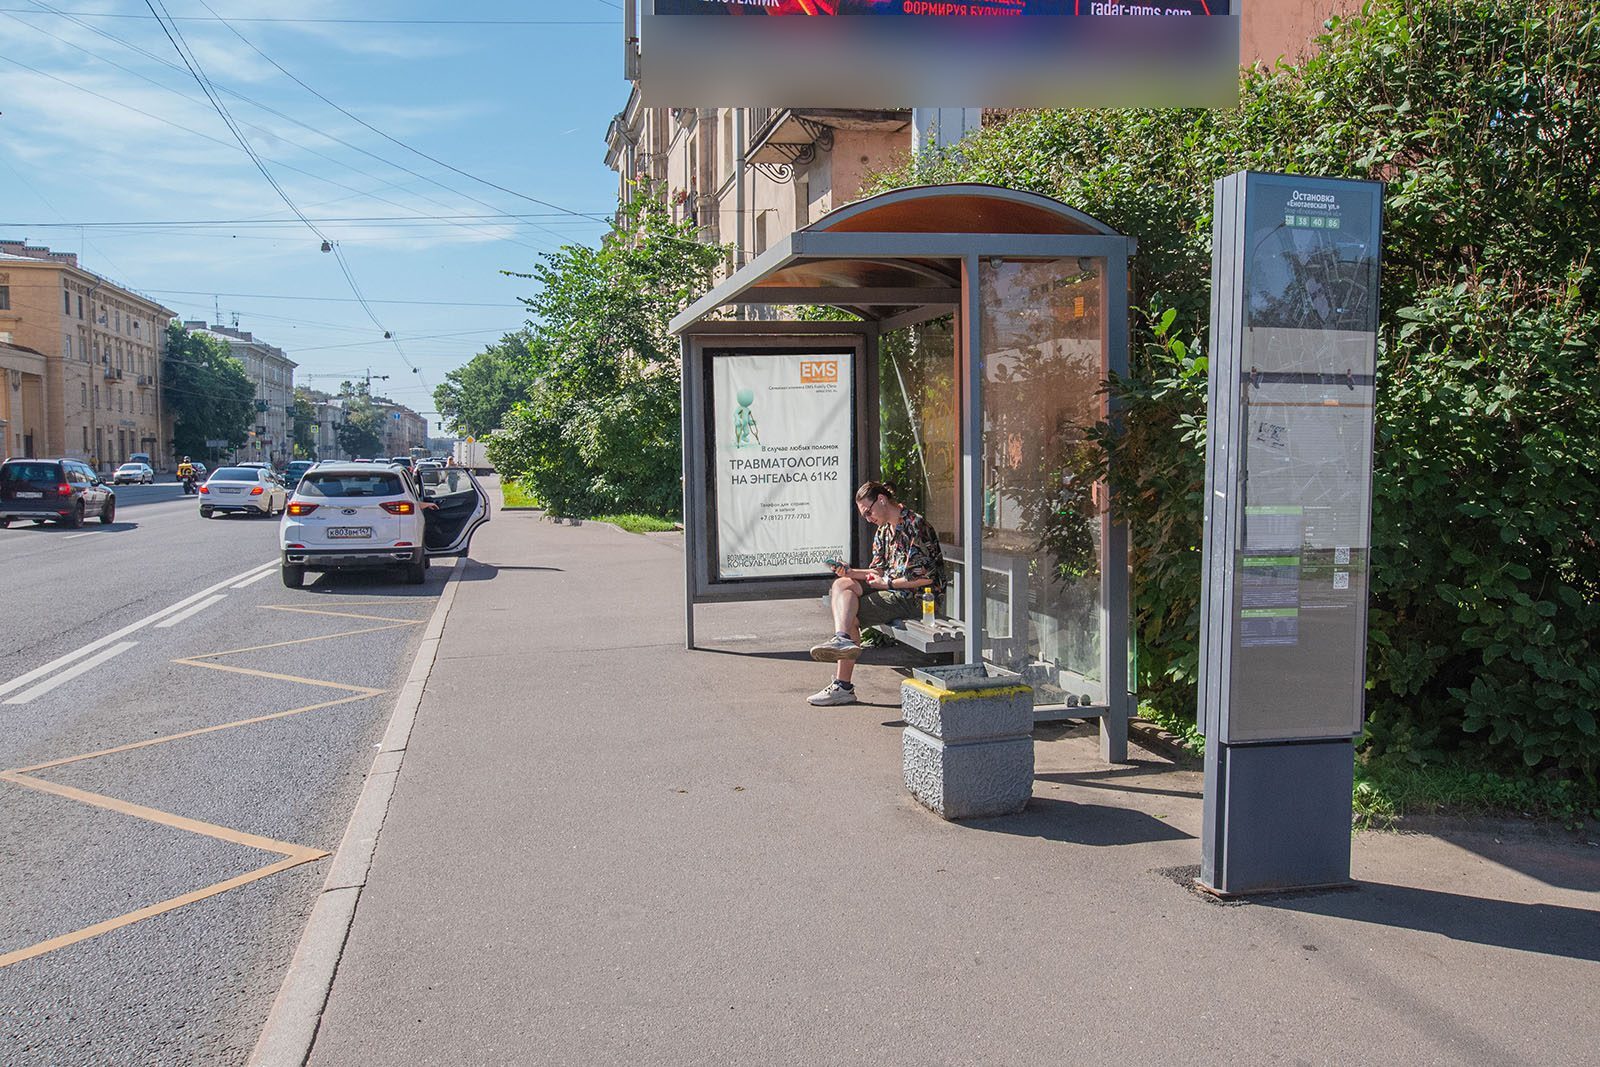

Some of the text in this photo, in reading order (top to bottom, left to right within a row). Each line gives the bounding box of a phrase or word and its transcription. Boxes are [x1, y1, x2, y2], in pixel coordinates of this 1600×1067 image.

[903, 1, 967, 16] ФОРМИРУЯ
[1090, 0, 1192, 16] radar-mmscom
[1292, 190, 1335, 203] Остановка
[1312, 218, 1322, 226] 40
[1328, 219, 1338, 228] 86
[802, 363, 836, 377] EMS
[729, 456, 839, 470] ТРАВМАТОЛОГИЯ
[731, 471, 838, 485] НА ЭНГЕЛЬСА 61К2
[727, 555, 843, 568] КОНСУЛЬТАЦИЯ СПЕЦИАЛИТА
